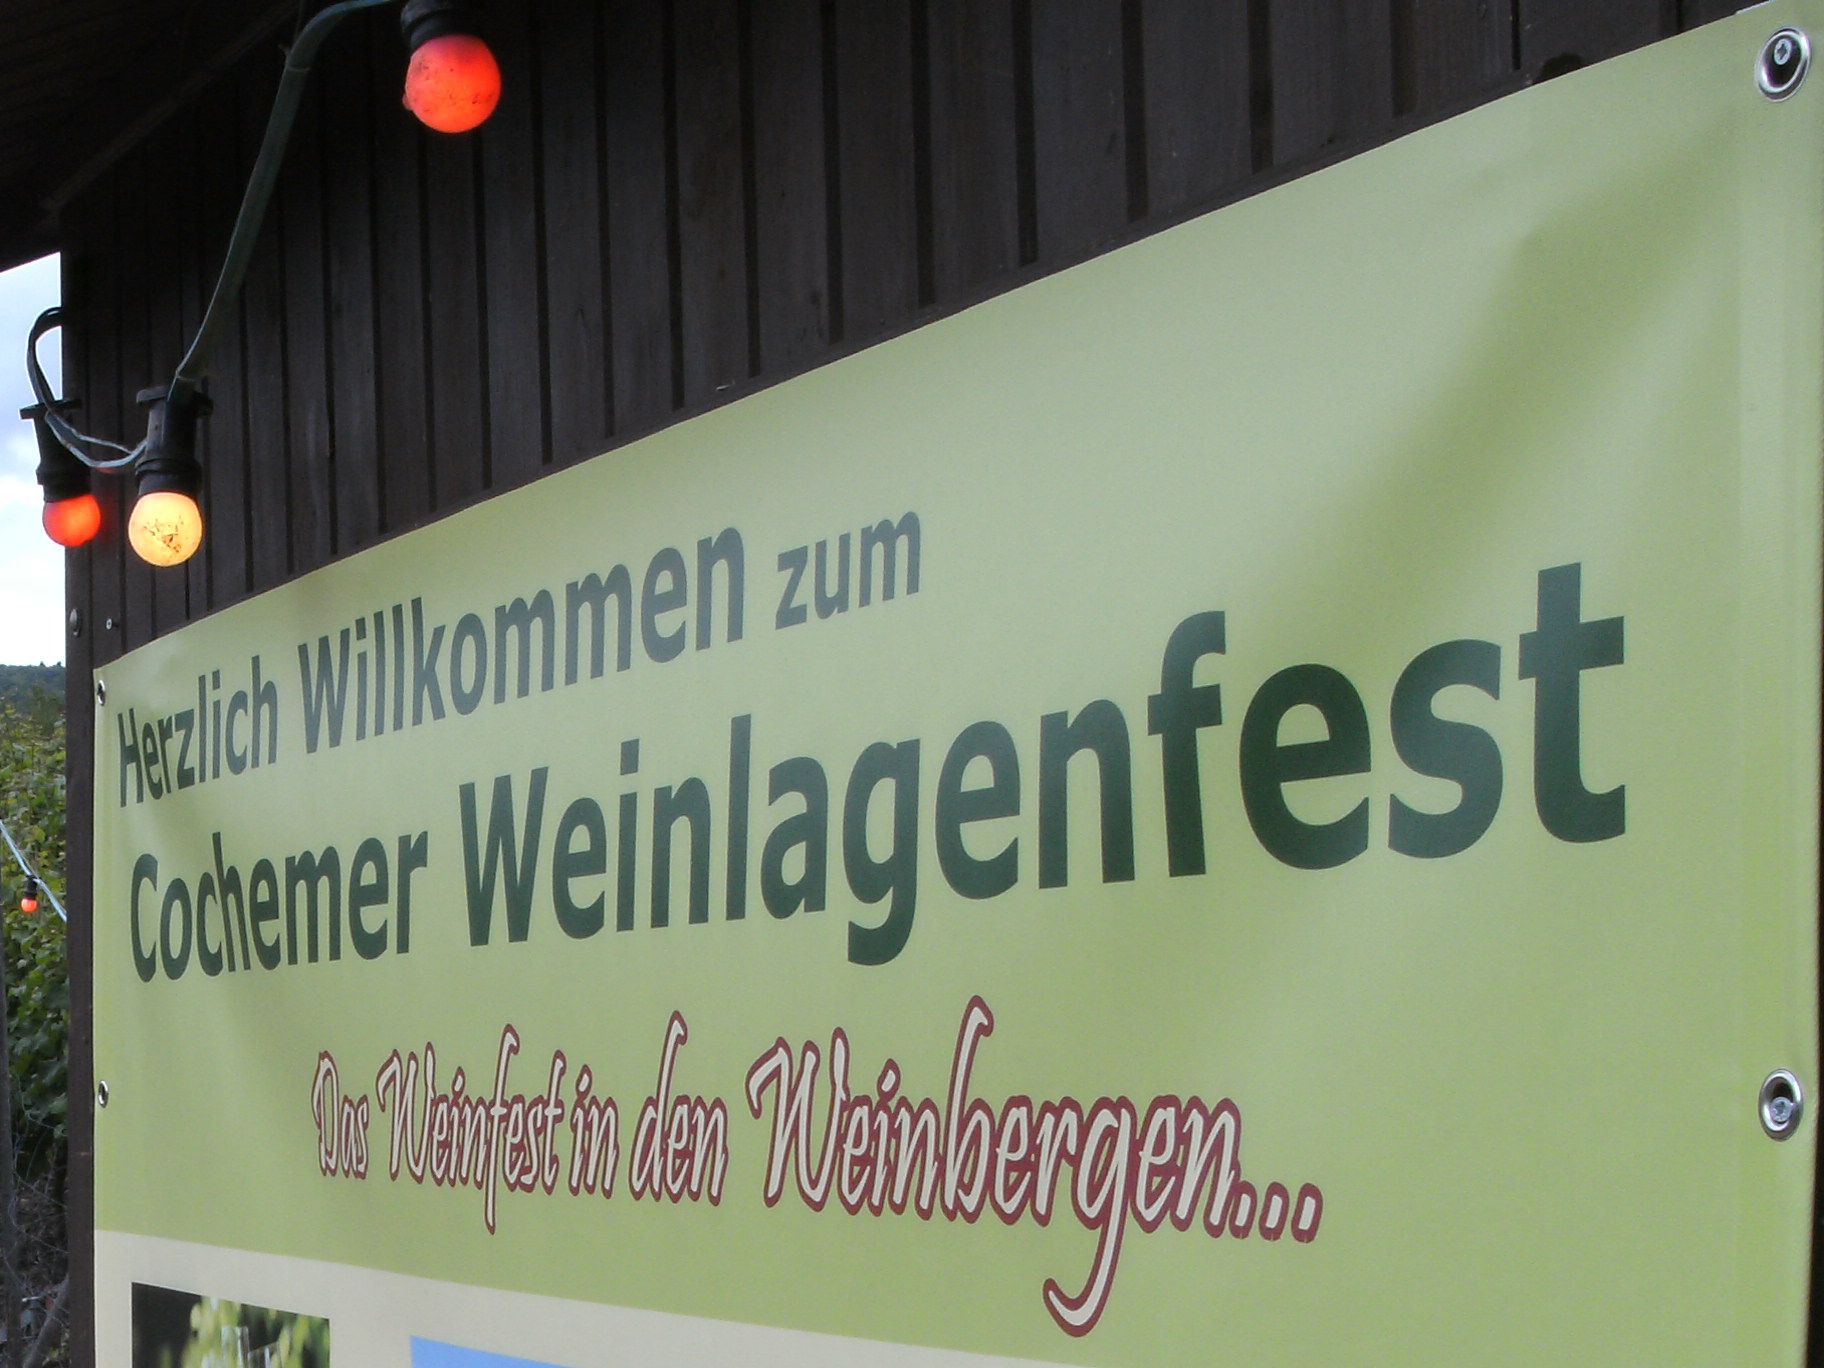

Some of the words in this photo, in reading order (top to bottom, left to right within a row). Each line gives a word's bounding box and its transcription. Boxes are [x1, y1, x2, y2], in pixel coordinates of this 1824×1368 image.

[119, 654, 279, 807] Herzlich
[298, 526, 745, 755] Willkommen
[775, 510, 921, 630] zum
[130, 830, 428, 984] Cochemer
[459, 562, 1626, 966] Weinlagenfest
[311, 1050, 368, 1181] Das
[376, 1024, 567, 1235] Weinfest
[568, 1064, 621, 1200] in
[629, 1010, 729, 1207] den
[744, 995, 1324, 1338] Weinbergen...
